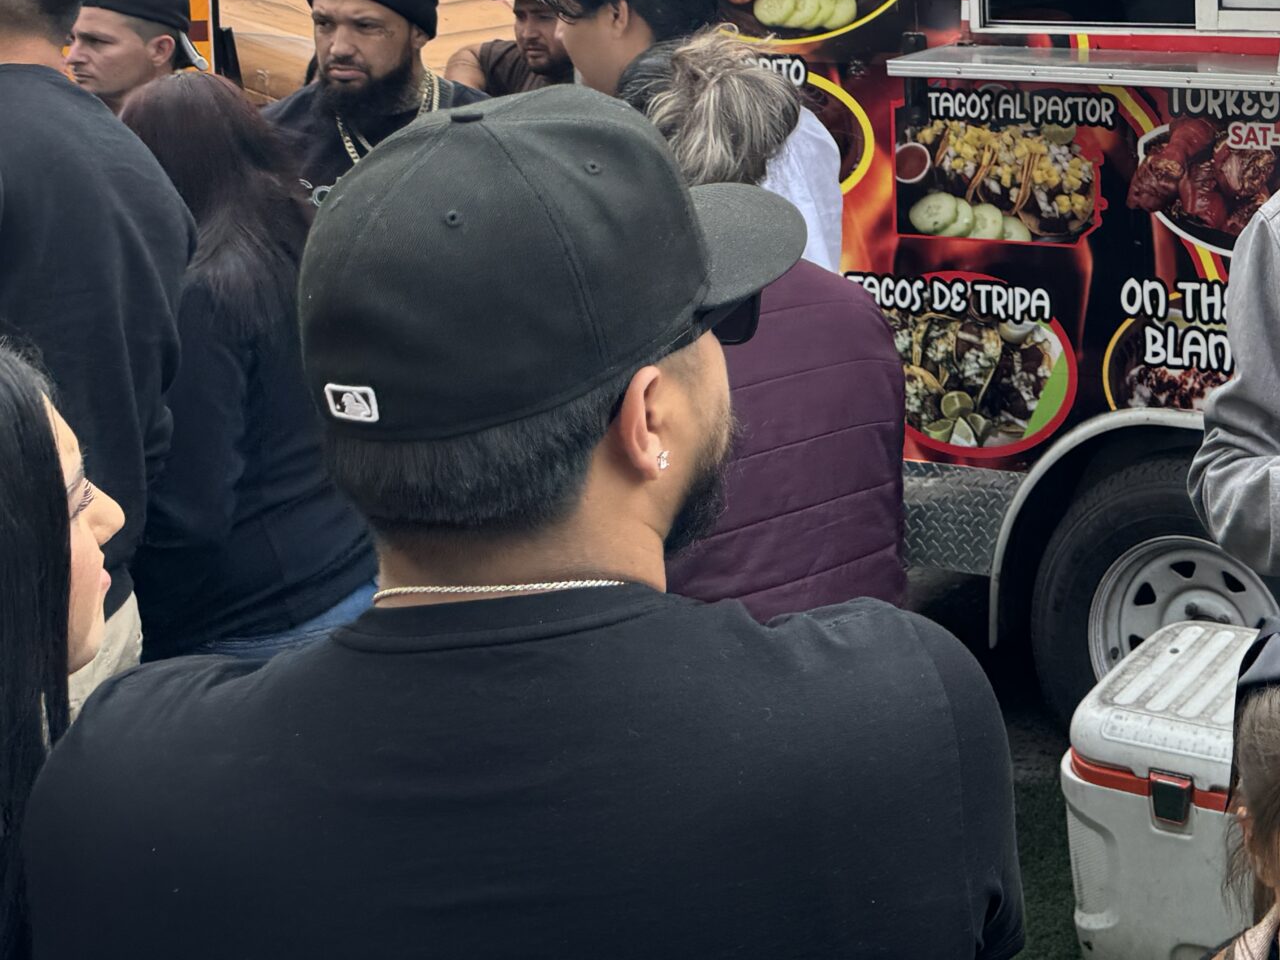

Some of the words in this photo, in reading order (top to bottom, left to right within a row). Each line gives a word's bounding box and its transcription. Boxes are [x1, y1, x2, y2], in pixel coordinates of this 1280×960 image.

[930, 90, 994, 118] TACOS
[999, 93, 1029, 120] AL
[1033, 95, 1114, 126] PASTOR
[1172, 89, 1280, 120] TURKEY
[931, 278, 967, 313] DE
[974, 283, 1051, 321] TRIPA
